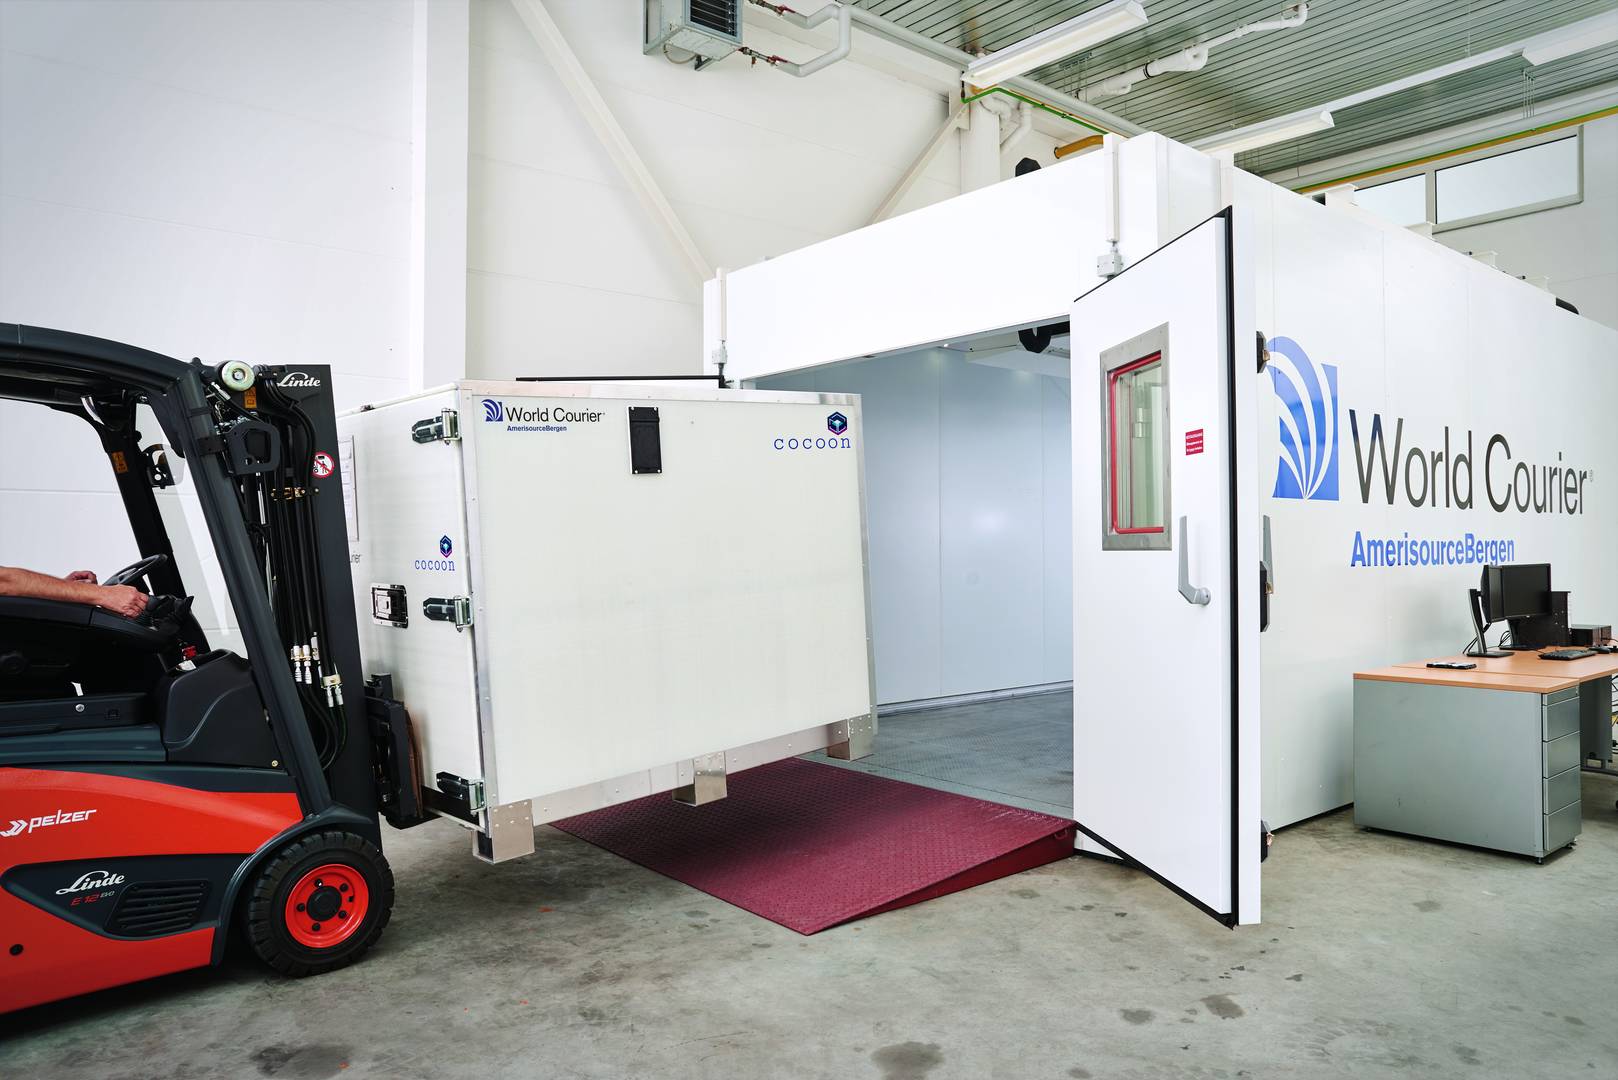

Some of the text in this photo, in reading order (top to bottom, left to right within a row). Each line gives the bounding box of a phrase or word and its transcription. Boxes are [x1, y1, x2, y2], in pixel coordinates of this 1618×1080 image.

[277, 372, 321, 387] Linde
[505, 407, 549, 422] World
[774, 437, 851, 450] cocoon
[1349, 409, 1473, 510] World
[1351, 531, 1515, 567] AmerisourceBergen
[415, 560, 455, 571] cocoon
[28, 809, 97, 833] pelzer
[56, 871, 125, 894] Linde
